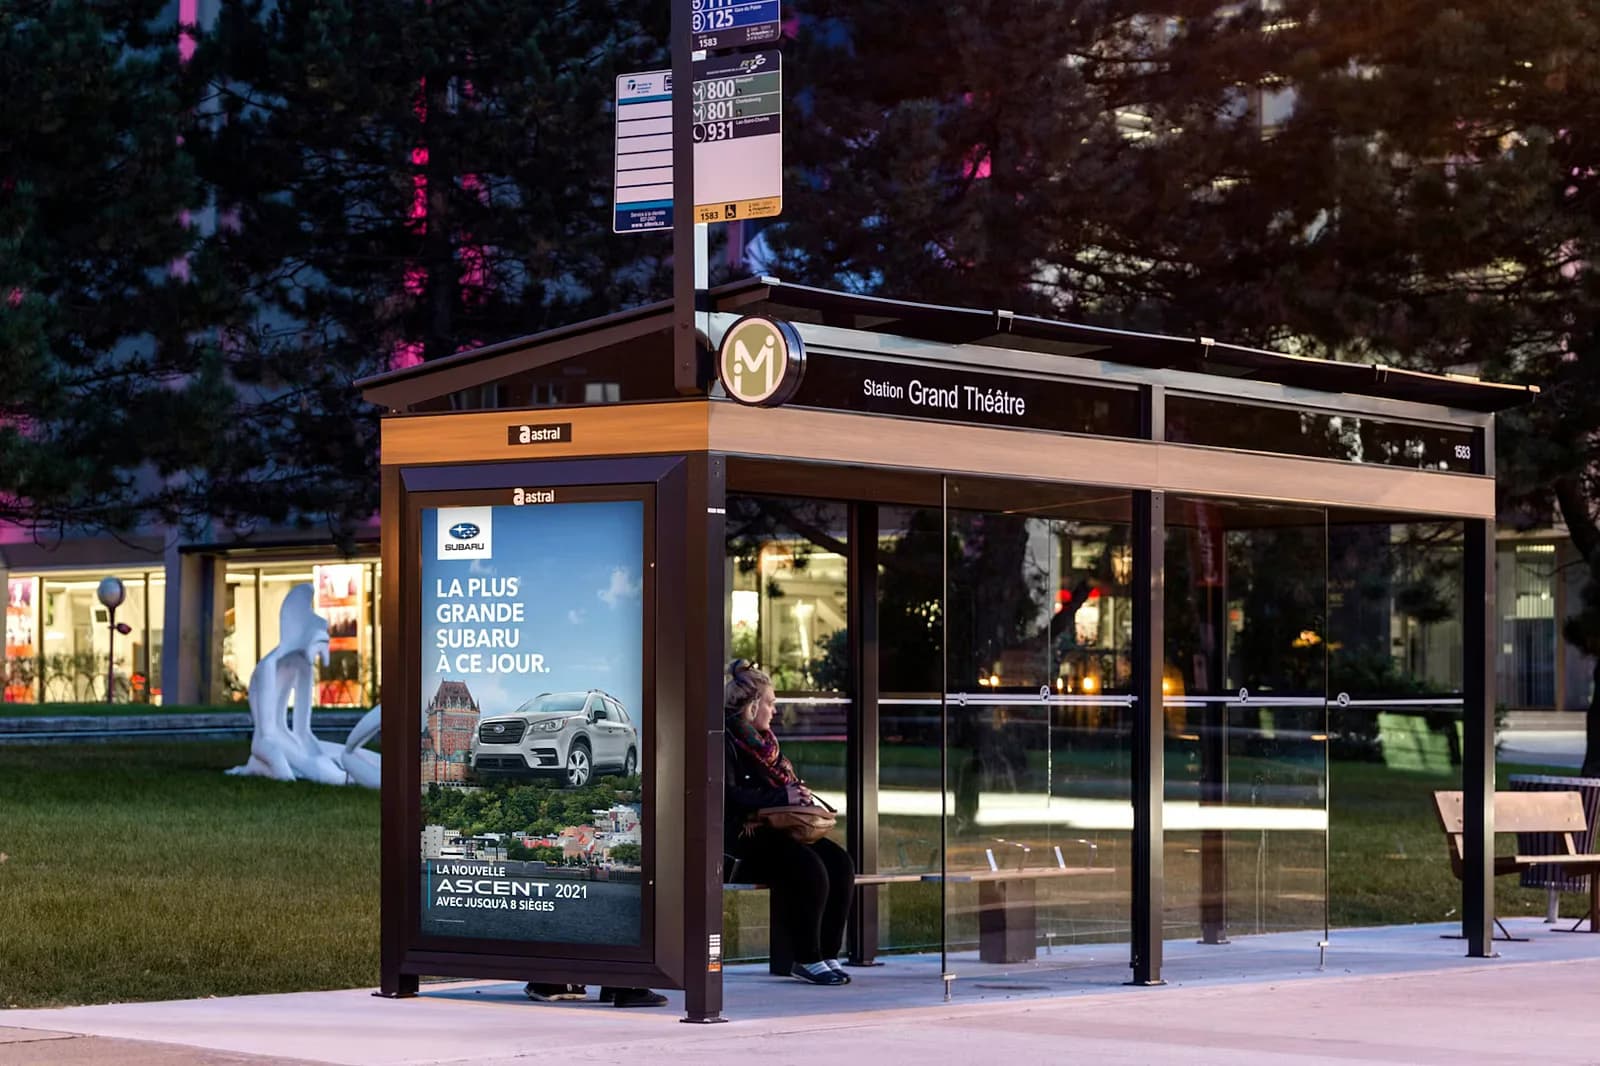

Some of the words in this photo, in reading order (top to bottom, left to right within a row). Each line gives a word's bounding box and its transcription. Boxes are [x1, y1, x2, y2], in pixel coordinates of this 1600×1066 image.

[707, 9, 734, 29] 125
[699, 38, 718, 48] 1583
[707, 80, 735, 99] 800
[707, 101, 734, 120] 801
[707, 121, 734, 141] 931
[700, 211, 719, 221] 1583
[863, 378, 904, 399] Station
[908, 379, 958, 409] Grand
[963, 385, 1026, 416] Théâtre
[1454, 445, 1471, 459] 1583
[444, 543, 485, 551] SUBARU
[436, 578, 464, 598] LA
[468, 577, 519, 598] PLUS
[436, 603, 525, 623] GRANDE
[436, 628, 520, 649] SUBARU
[435, 649, 451, 673] À
[455, 653, 483, 674] CE
[486, 653, 551, 674] JOUR.
[436, 864, 450, 875] LA
[451, 865, 506, 877] NOUVELLE
[436, 879, 550, 896] ASCENT
[555, 884, 587, 899] 2021
[435, 896, 463, 908] AVEC
[510, 901, 517, 910] 8
[519, 898, 555, 911] SIÈGES
